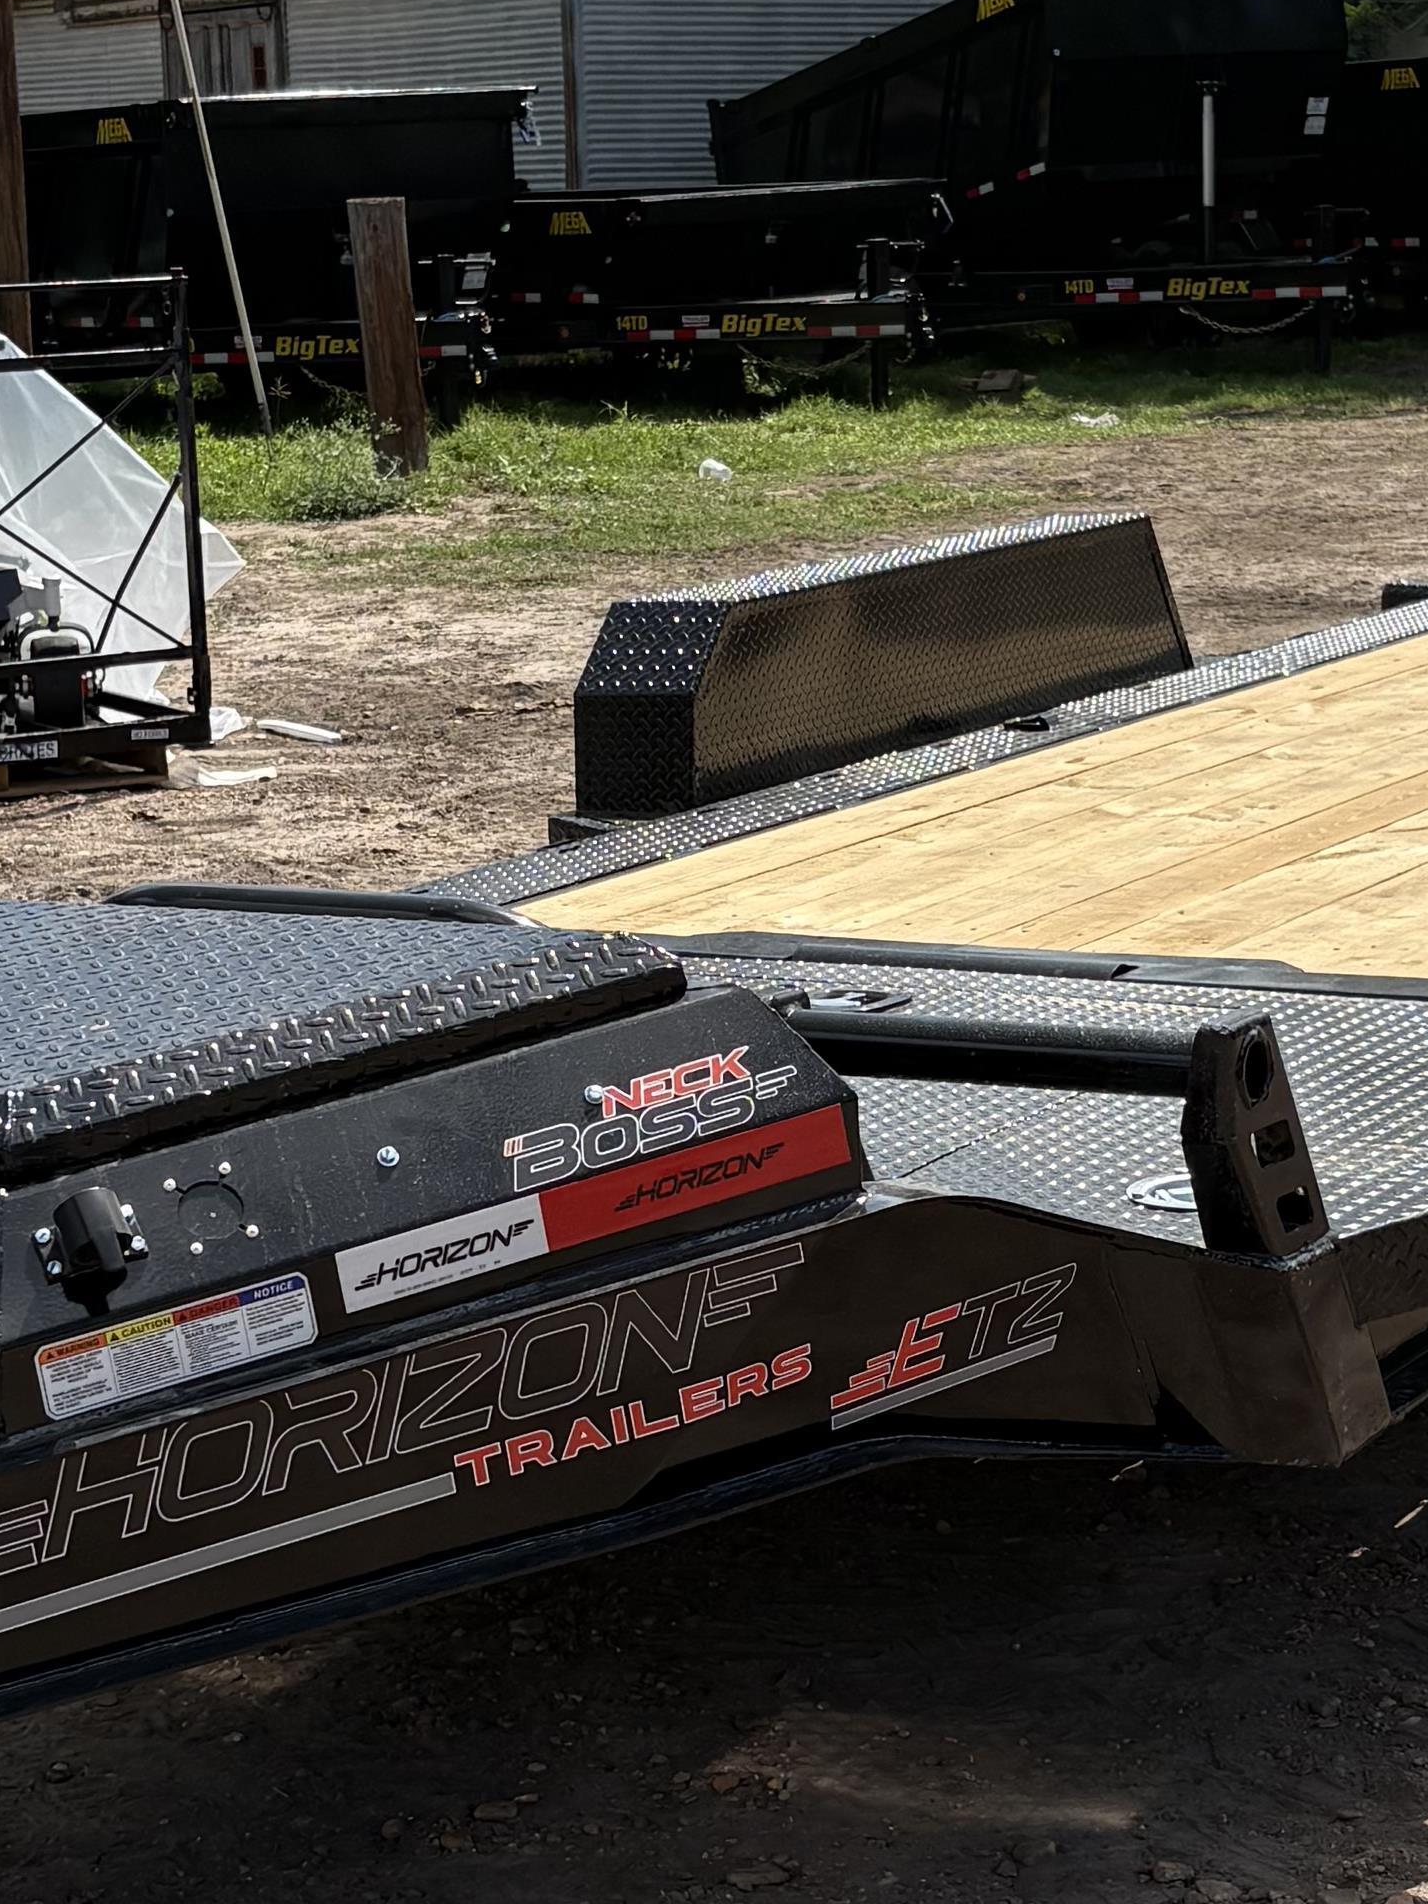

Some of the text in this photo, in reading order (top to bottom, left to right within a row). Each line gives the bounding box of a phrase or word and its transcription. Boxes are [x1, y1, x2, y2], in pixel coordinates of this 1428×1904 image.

[1380, 67, 1421, 91] MEGA
[549, 211, 592, 236] MEGA
[1064, 279, 1094, 294] 14TD
[1167, 277, 1250, 300] BigTex
[616, 315, 648, 331] 14TD
[722, 313, 807, 338] BigTex
[275, 335, 362, 361] BigTex
[600, 1045, 750, 1117] NECK
[513, 1078, 756, 1191] BOSS
[627, 1144, 774, 1207] HORIZON
[368, 1222, 522, 1288] HORIZON
[254, 1280, 294, 1300] NOTICE
[188, 1297, 237, 1319] DANGER
[121, 1316, 171, 1338] CAUTION
[56, 1338, 100, 1357] WARNING
[2, 1264, 732, 1571] HORIZON
[452, 1343, 813, 1487] TRAILERS
